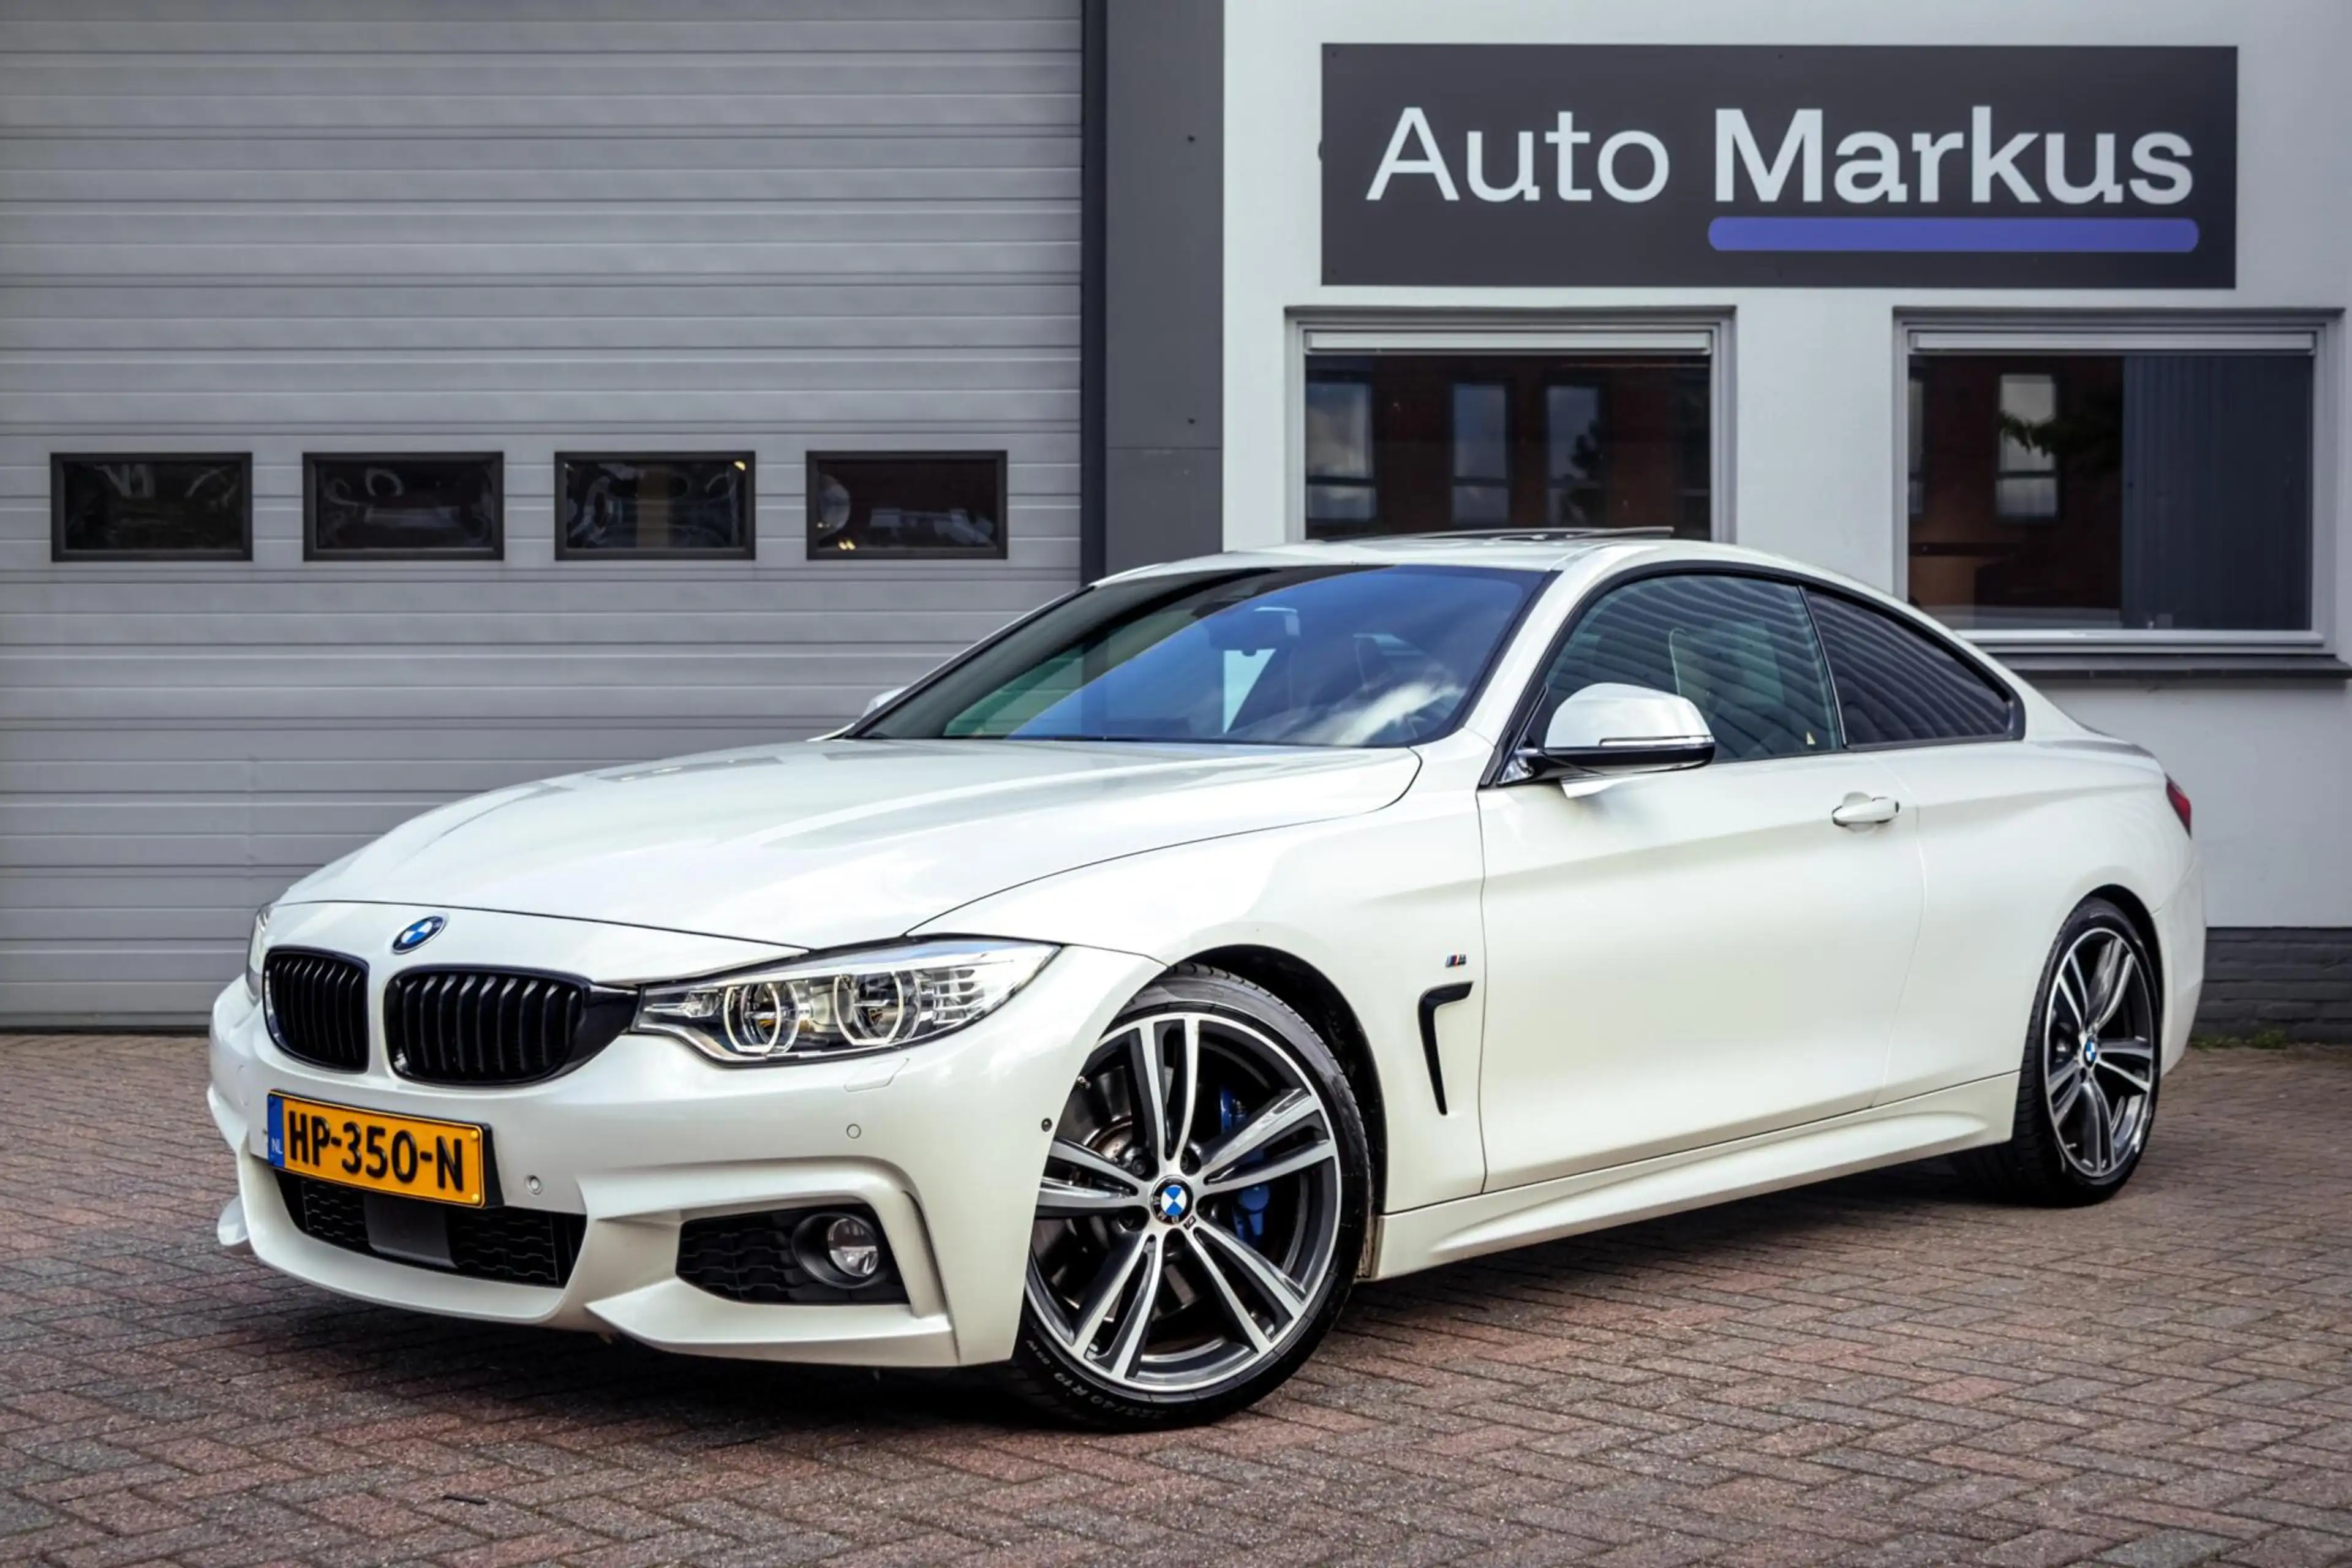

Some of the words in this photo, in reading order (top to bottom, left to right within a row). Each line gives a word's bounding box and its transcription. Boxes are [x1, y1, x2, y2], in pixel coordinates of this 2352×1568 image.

[1366, 107, 1669, 203] Auto
[1716, 106, 2192, 203] Markus
[271, 1137, 283, 1155] NL
[288, 1110, 464, 1192] HP-350-N
